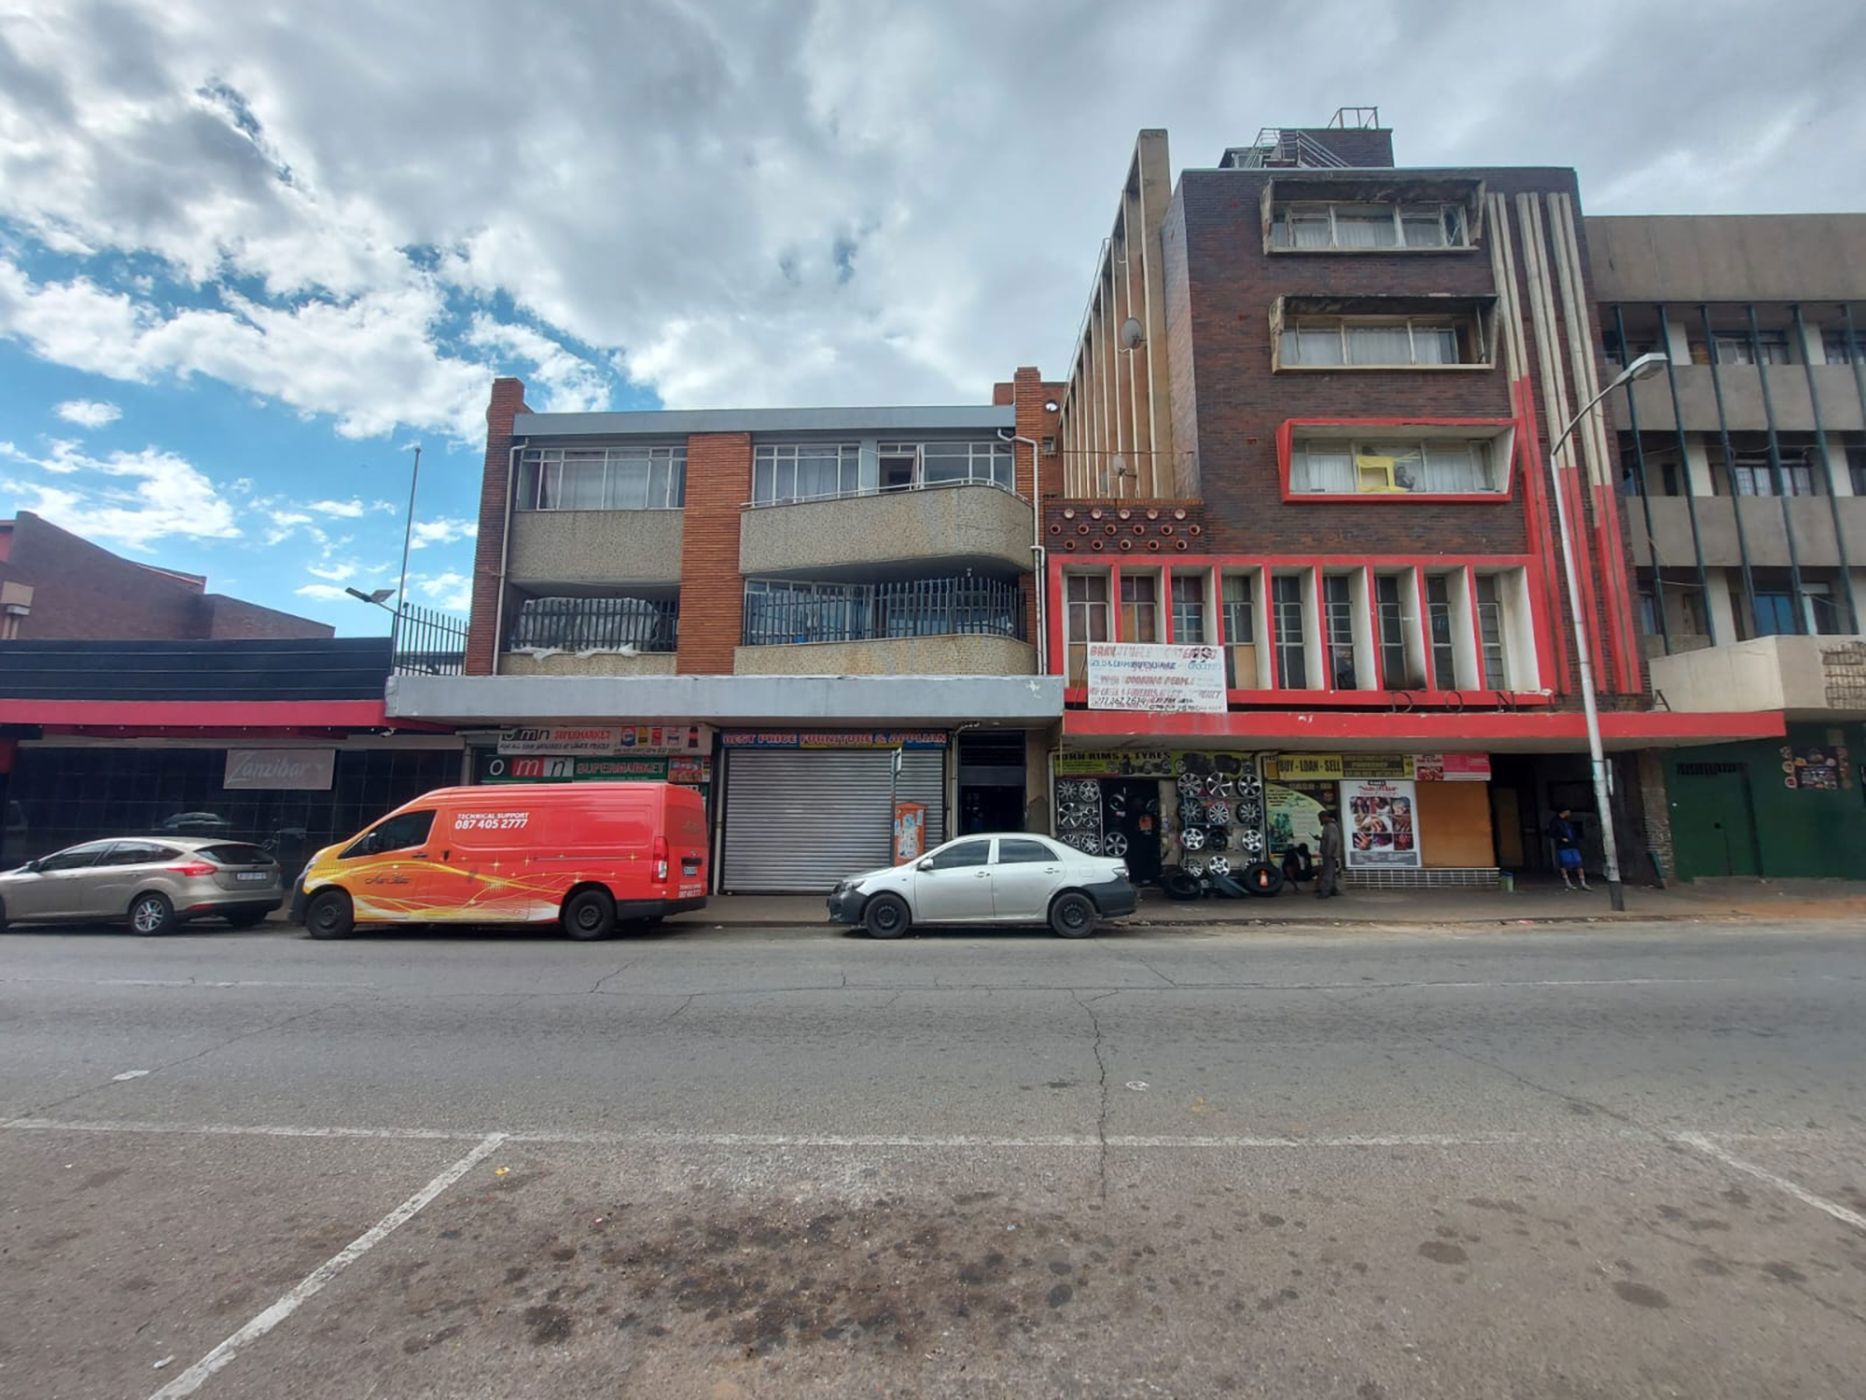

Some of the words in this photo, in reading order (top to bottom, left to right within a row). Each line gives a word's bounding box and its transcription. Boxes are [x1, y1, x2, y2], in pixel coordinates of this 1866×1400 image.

[758, 734, 798, 745] PRICE
[800, 734, 873, 745] FURNITURE
[226, 752, 310, 784] Zanzibar
[576, 762, 665, 775] SUPERMARKET
[1278, 760, 1294, 772] BUY
[1300, 760, 1319, 772] LOAN
[1324, 759, 1340, 772] SELL
[454, 820, 476, 830] 087
[477, 819, 499, 830] 405
[501, 819, 528, 829] 2777
